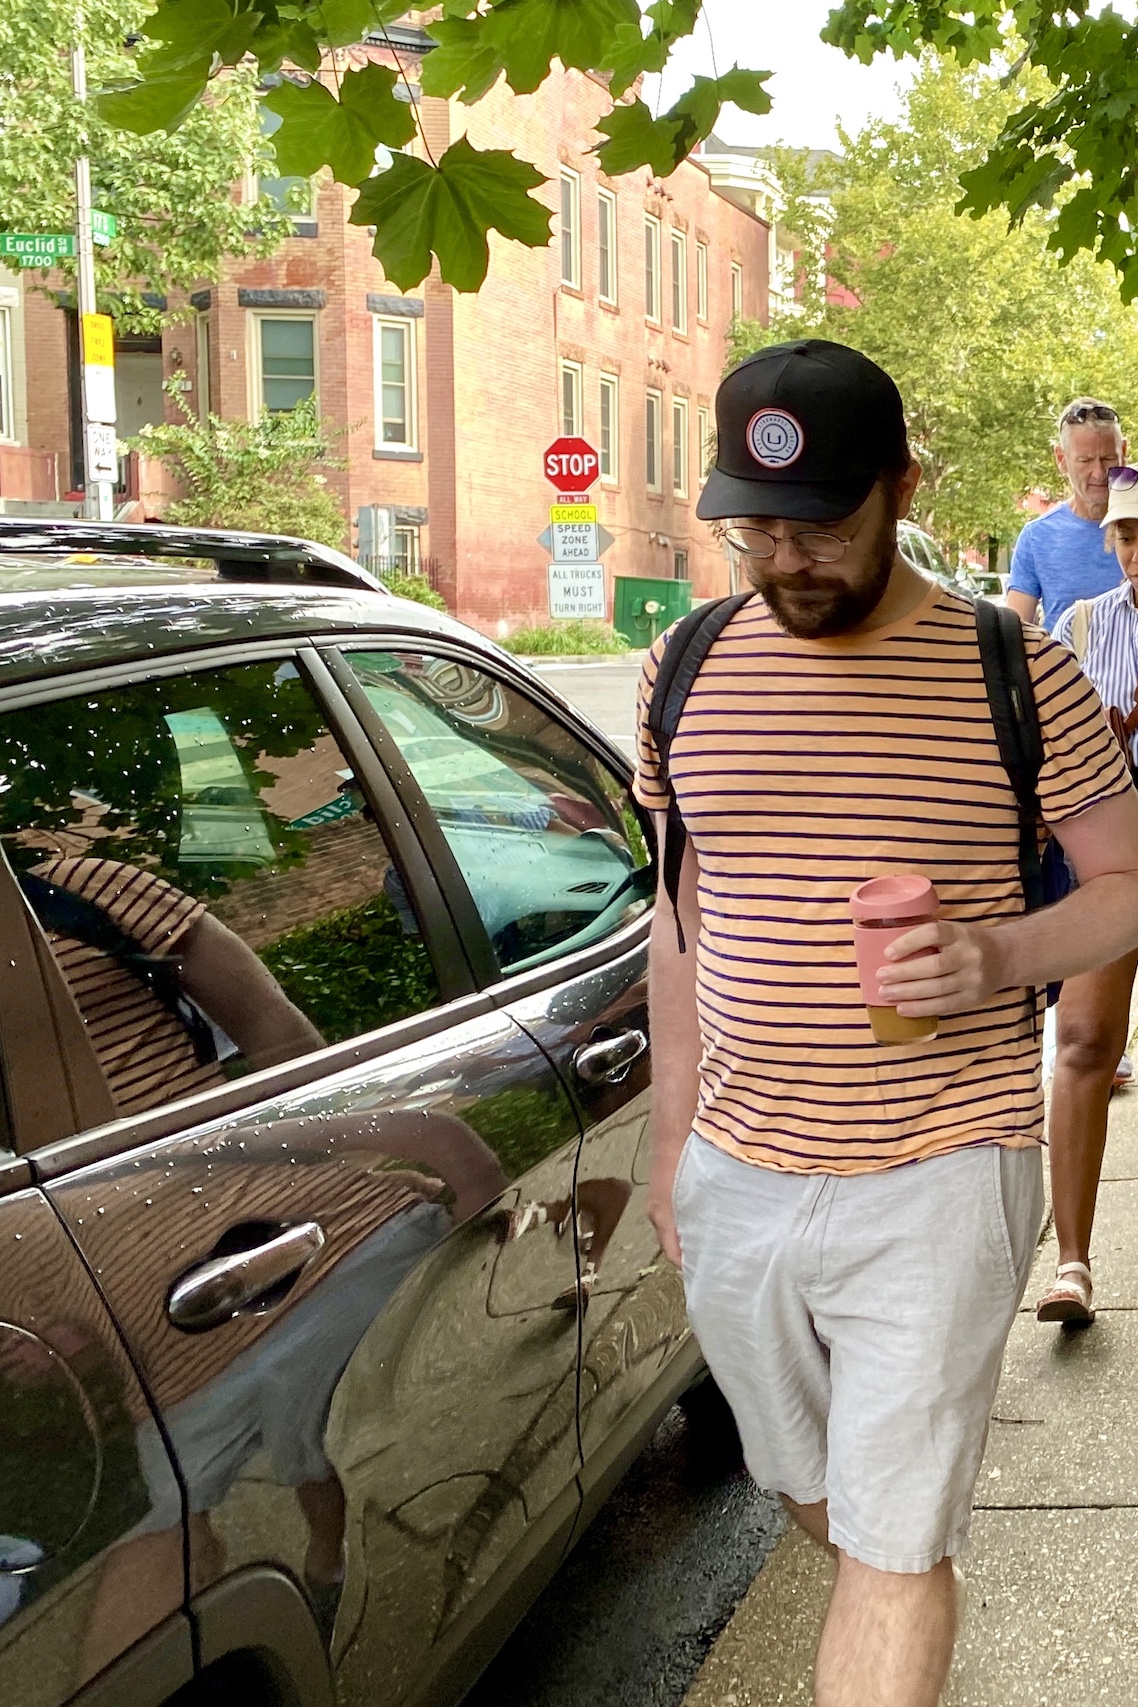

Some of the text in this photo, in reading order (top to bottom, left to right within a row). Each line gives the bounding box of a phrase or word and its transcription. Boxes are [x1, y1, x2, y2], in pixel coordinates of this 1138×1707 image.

[6, 236, 55, 253] Euclid
[22, 254, 52, 267] 1700
[93, 431, 111, 445] ONE
[94, 447, 112, 457] WAY
[546, 453, 597, 476] STOP
[555, 510, 592, 520] SCHOOL
[557, 524, 591, 533] SPEED
[561, 535, 588, 544] ZONE
[562, 548, 589, 557] AHEAD
[552, 570, 601, 579] ALL TRUCKS
[563, 586, 593, 597] MUST
[554, 603, 602, 612] TURN RIGHT
